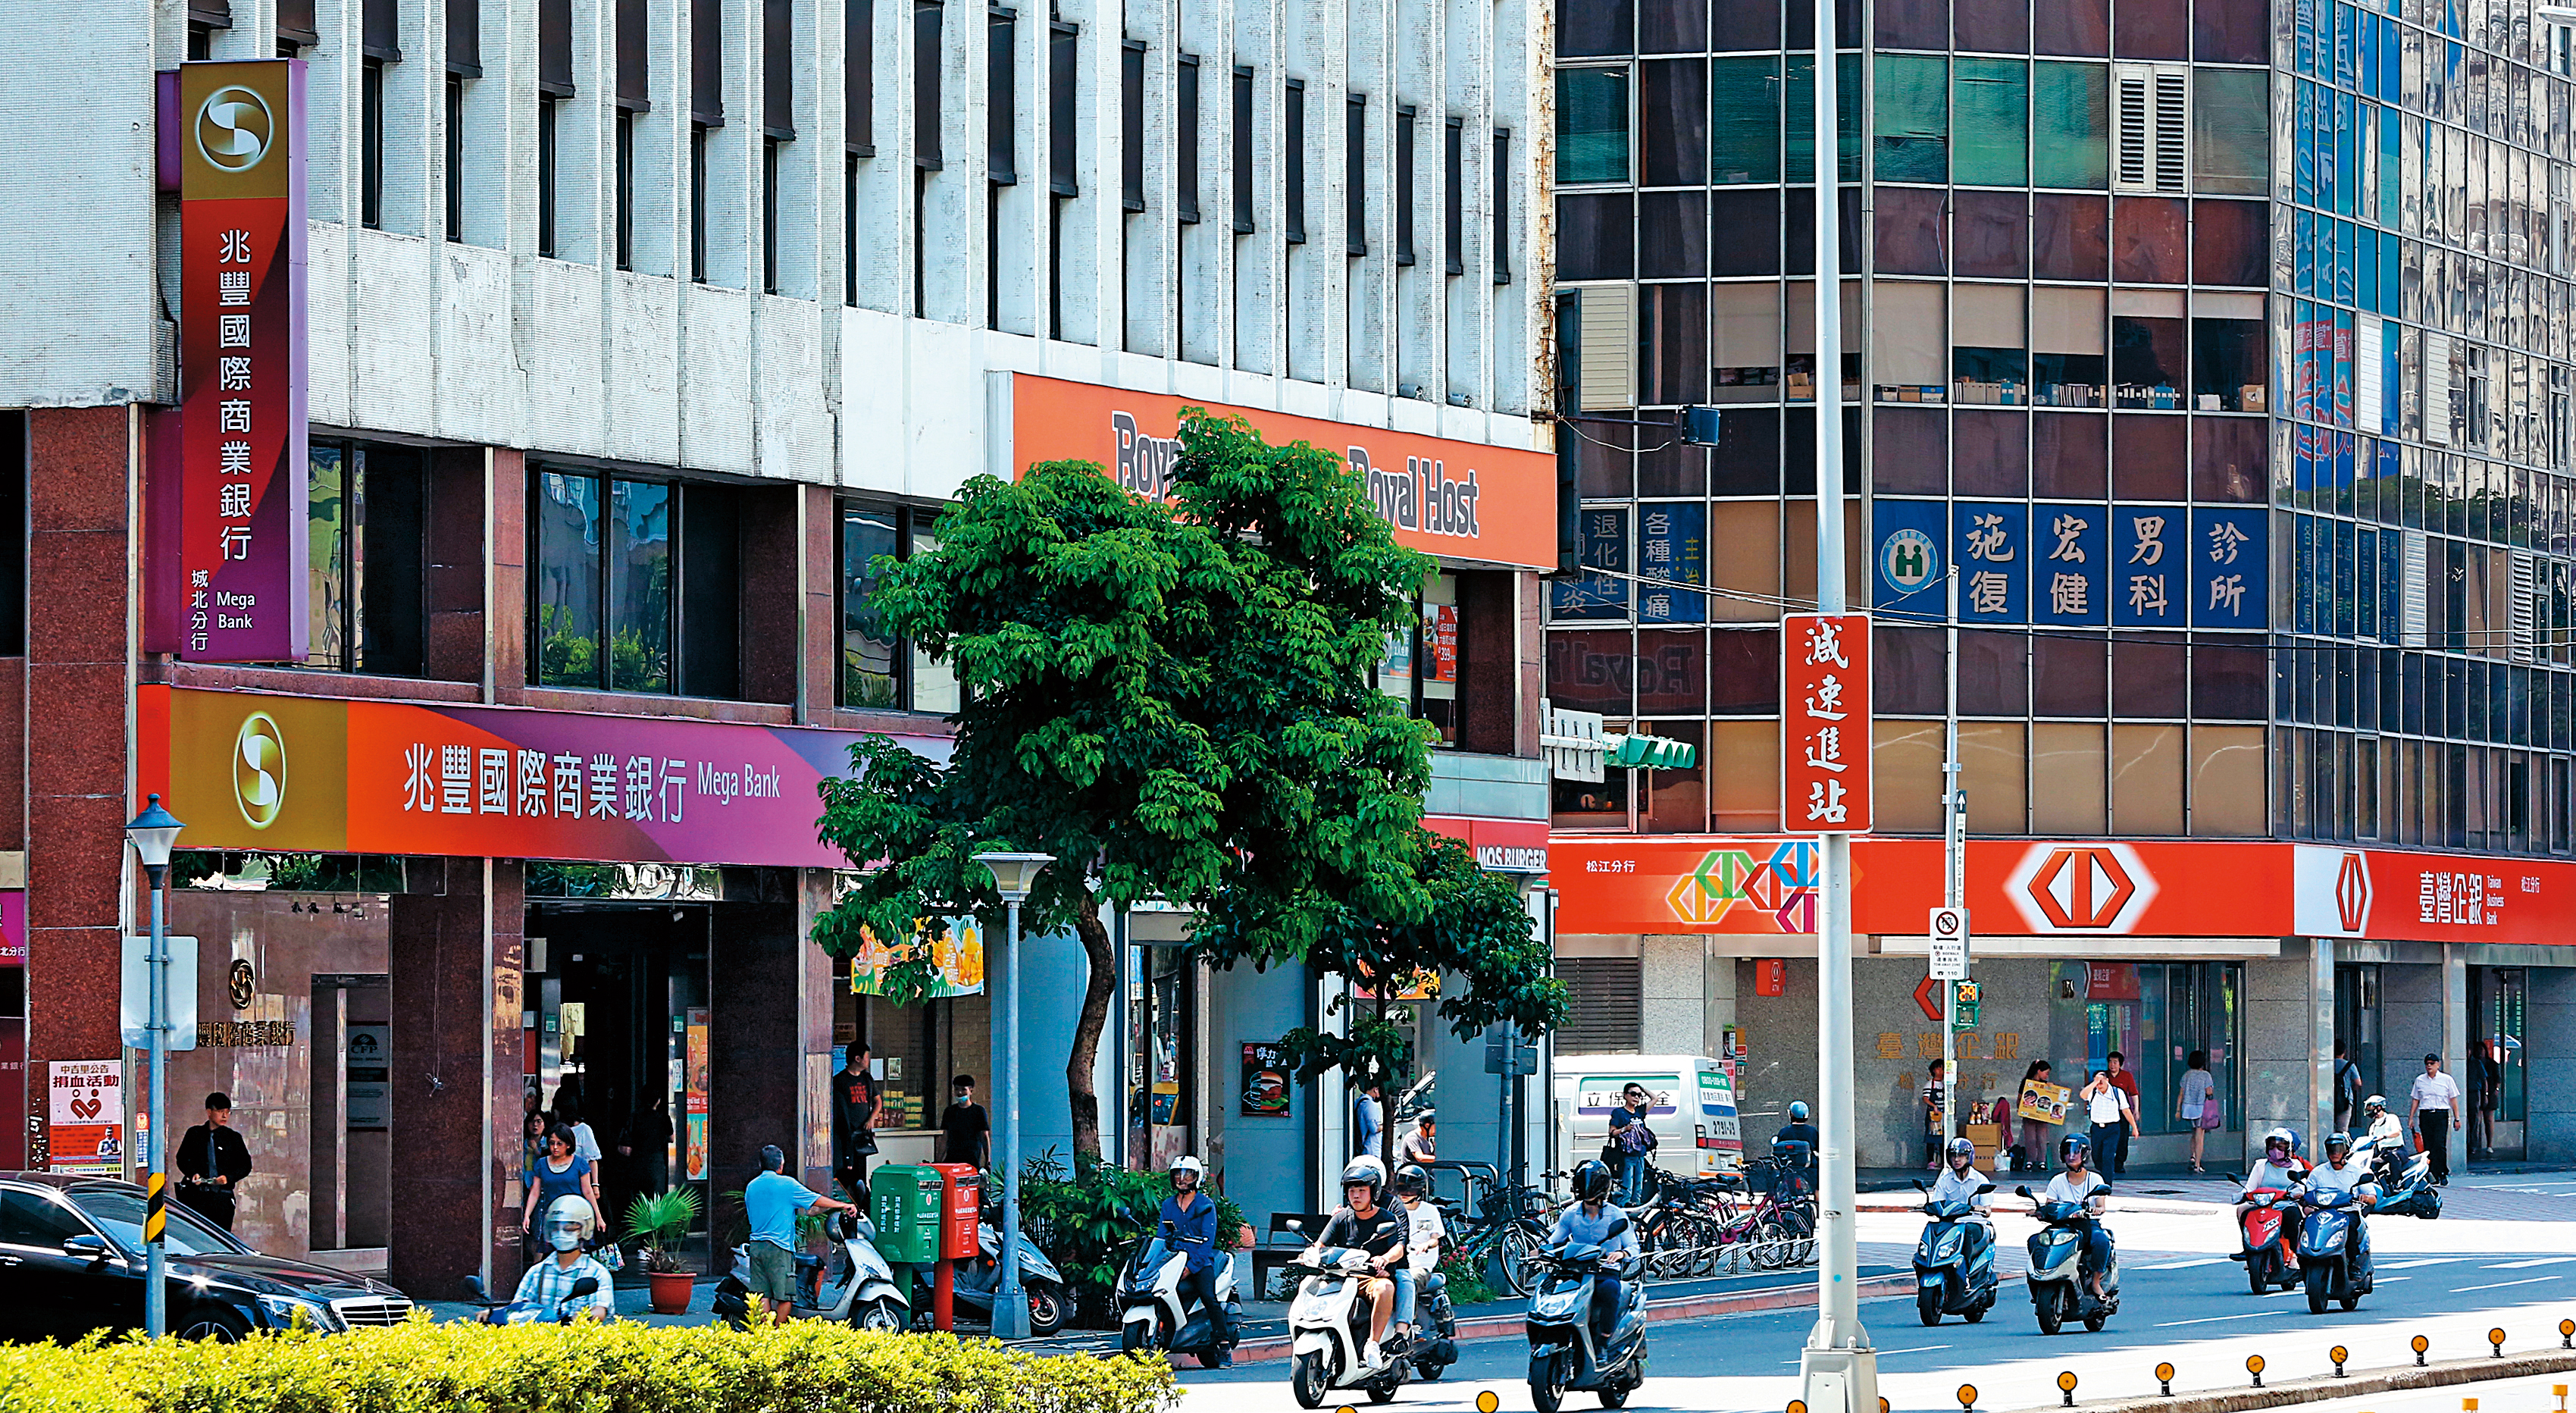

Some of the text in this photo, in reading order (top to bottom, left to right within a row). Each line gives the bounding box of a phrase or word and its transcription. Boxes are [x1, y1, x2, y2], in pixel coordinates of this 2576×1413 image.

[219, 228, 252, 562] 兆豐國際商業銀行
[1112, 410, 1197, 503] Roy
[1421, 458, 1479, 539] Host
[1593, 514, 1619, 595] 退化性
[1645, 512, 1670, 616] 各種酸痛
[2208, 522, 2249, 617] 診所
[191, 569, 210, 652] 城北分行
[217, 590, 255, 609] Mega
[218, 613, 252, 629] Bank
[1804, 622, 1848, 824] 減速進站
[403, 741, 687, 824] 兆豐國際商業銀行
[697, 760, 781, 809] Mega Bank
[1476, 846, 1547, 869] MOS BURGER
[1586, 860, 1635, 873] 松江分行
[2487, 875, 2501, 888] Taiwan
[2521, 876, 2540, 893] 松江分行
[2419, 871, 2483, 925] 臺灣企銀
[2487, 893, 2504, 907] Business
[2487, 911, 2498, 925] Bank
[1958, 985, 1976, 1002] 29
[351, 1045, 378, 1054] CFP
[53, 1075, 120, 1088] 捐血活動
[1898, 1071, 1998, 1090] 松分行
